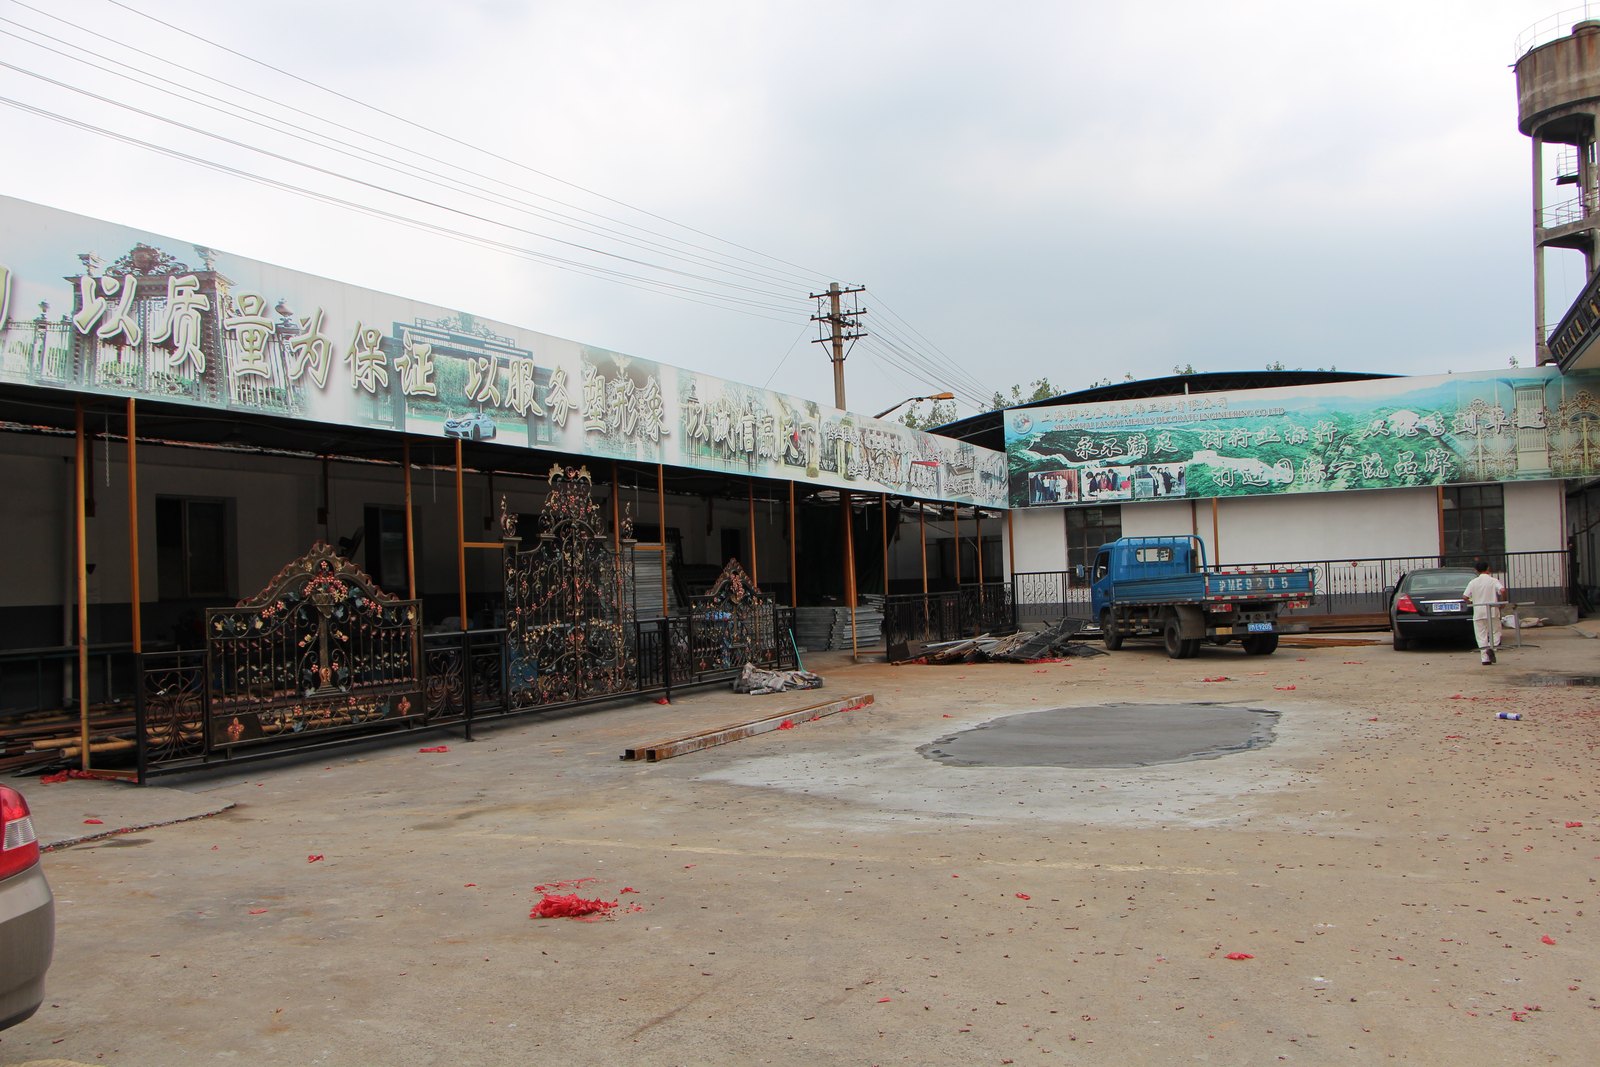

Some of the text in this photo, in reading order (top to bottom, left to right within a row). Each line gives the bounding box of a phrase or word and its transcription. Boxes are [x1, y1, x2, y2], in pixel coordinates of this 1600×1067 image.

[72, 274, 437, 396] 以质量为保证
[464, 355, 670, 442] 以服务塑形象
[687, 398, 815, 464] 以诚信赢天下
[1075, 432, 1179, 460] 永不满足
[1198, 420, 1338, 449] 树行业标杆
[1212, 448, 1451, 487] 打造国际一流品牌
